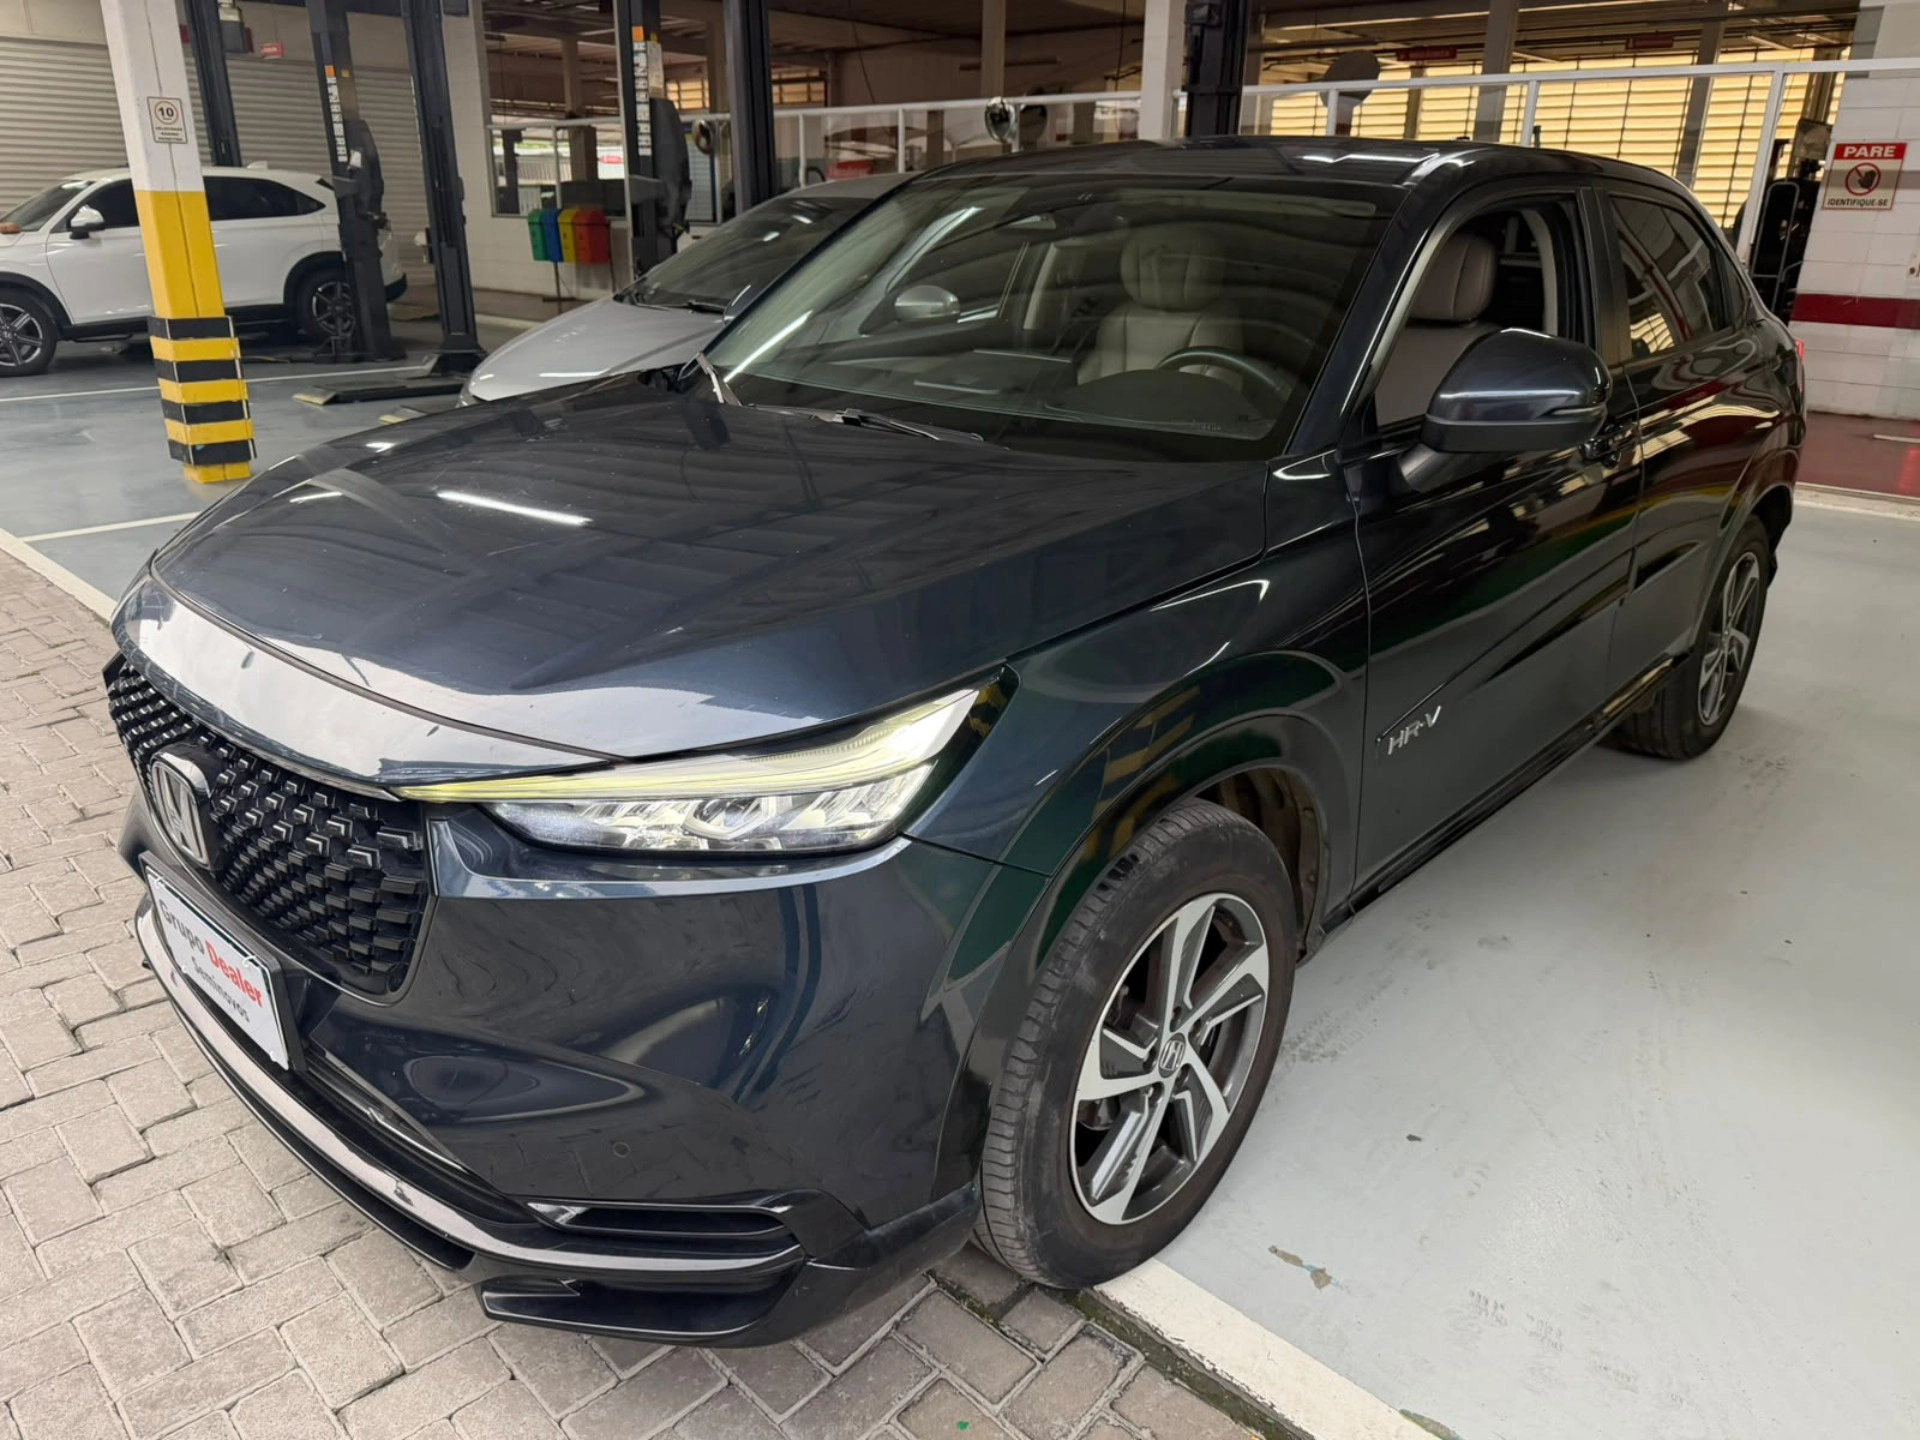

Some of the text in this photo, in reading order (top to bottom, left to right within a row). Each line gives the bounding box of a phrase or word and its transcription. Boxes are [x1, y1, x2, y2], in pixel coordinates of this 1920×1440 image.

[159, 106, 175, 117] 10
[1842, 145, 1897, 158] PARE
[1827, 197, 1889, 208] IDENTIFIQUE-SE
[1387, 705, 1442, 756] HR-V
[158, 898, 264, 1009] Grupo Dealer
[191, 955, 250, 1023] Seminovos
